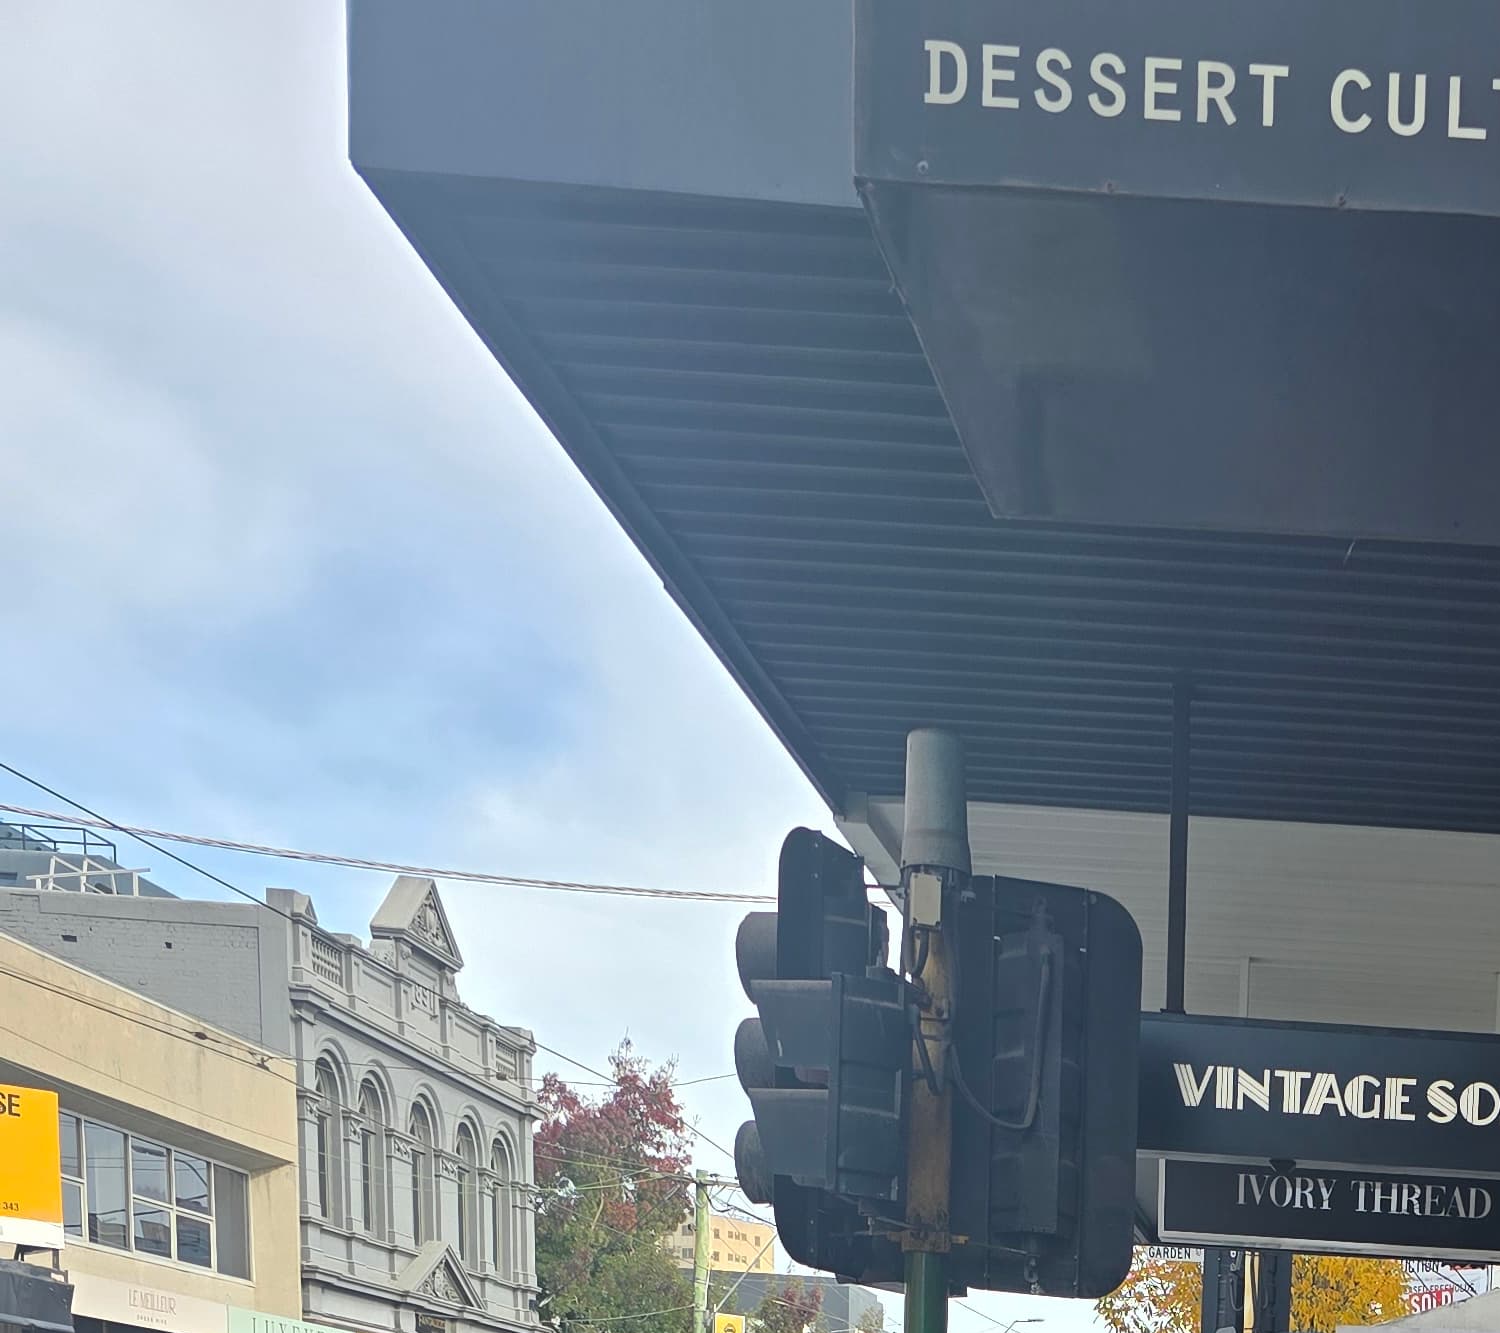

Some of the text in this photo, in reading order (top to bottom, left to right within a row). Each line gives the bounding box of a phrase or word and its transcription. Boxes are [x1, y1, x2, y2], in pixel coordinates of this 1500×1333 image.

[924, 38, 1290, 128] DESSERT
[1173, 1062, 1418, 1122] VINTAGE
[1236, 1172, 1492, 1220] IVORY THREAD
[1148, 1246, 1192, 1260] GARDEN
